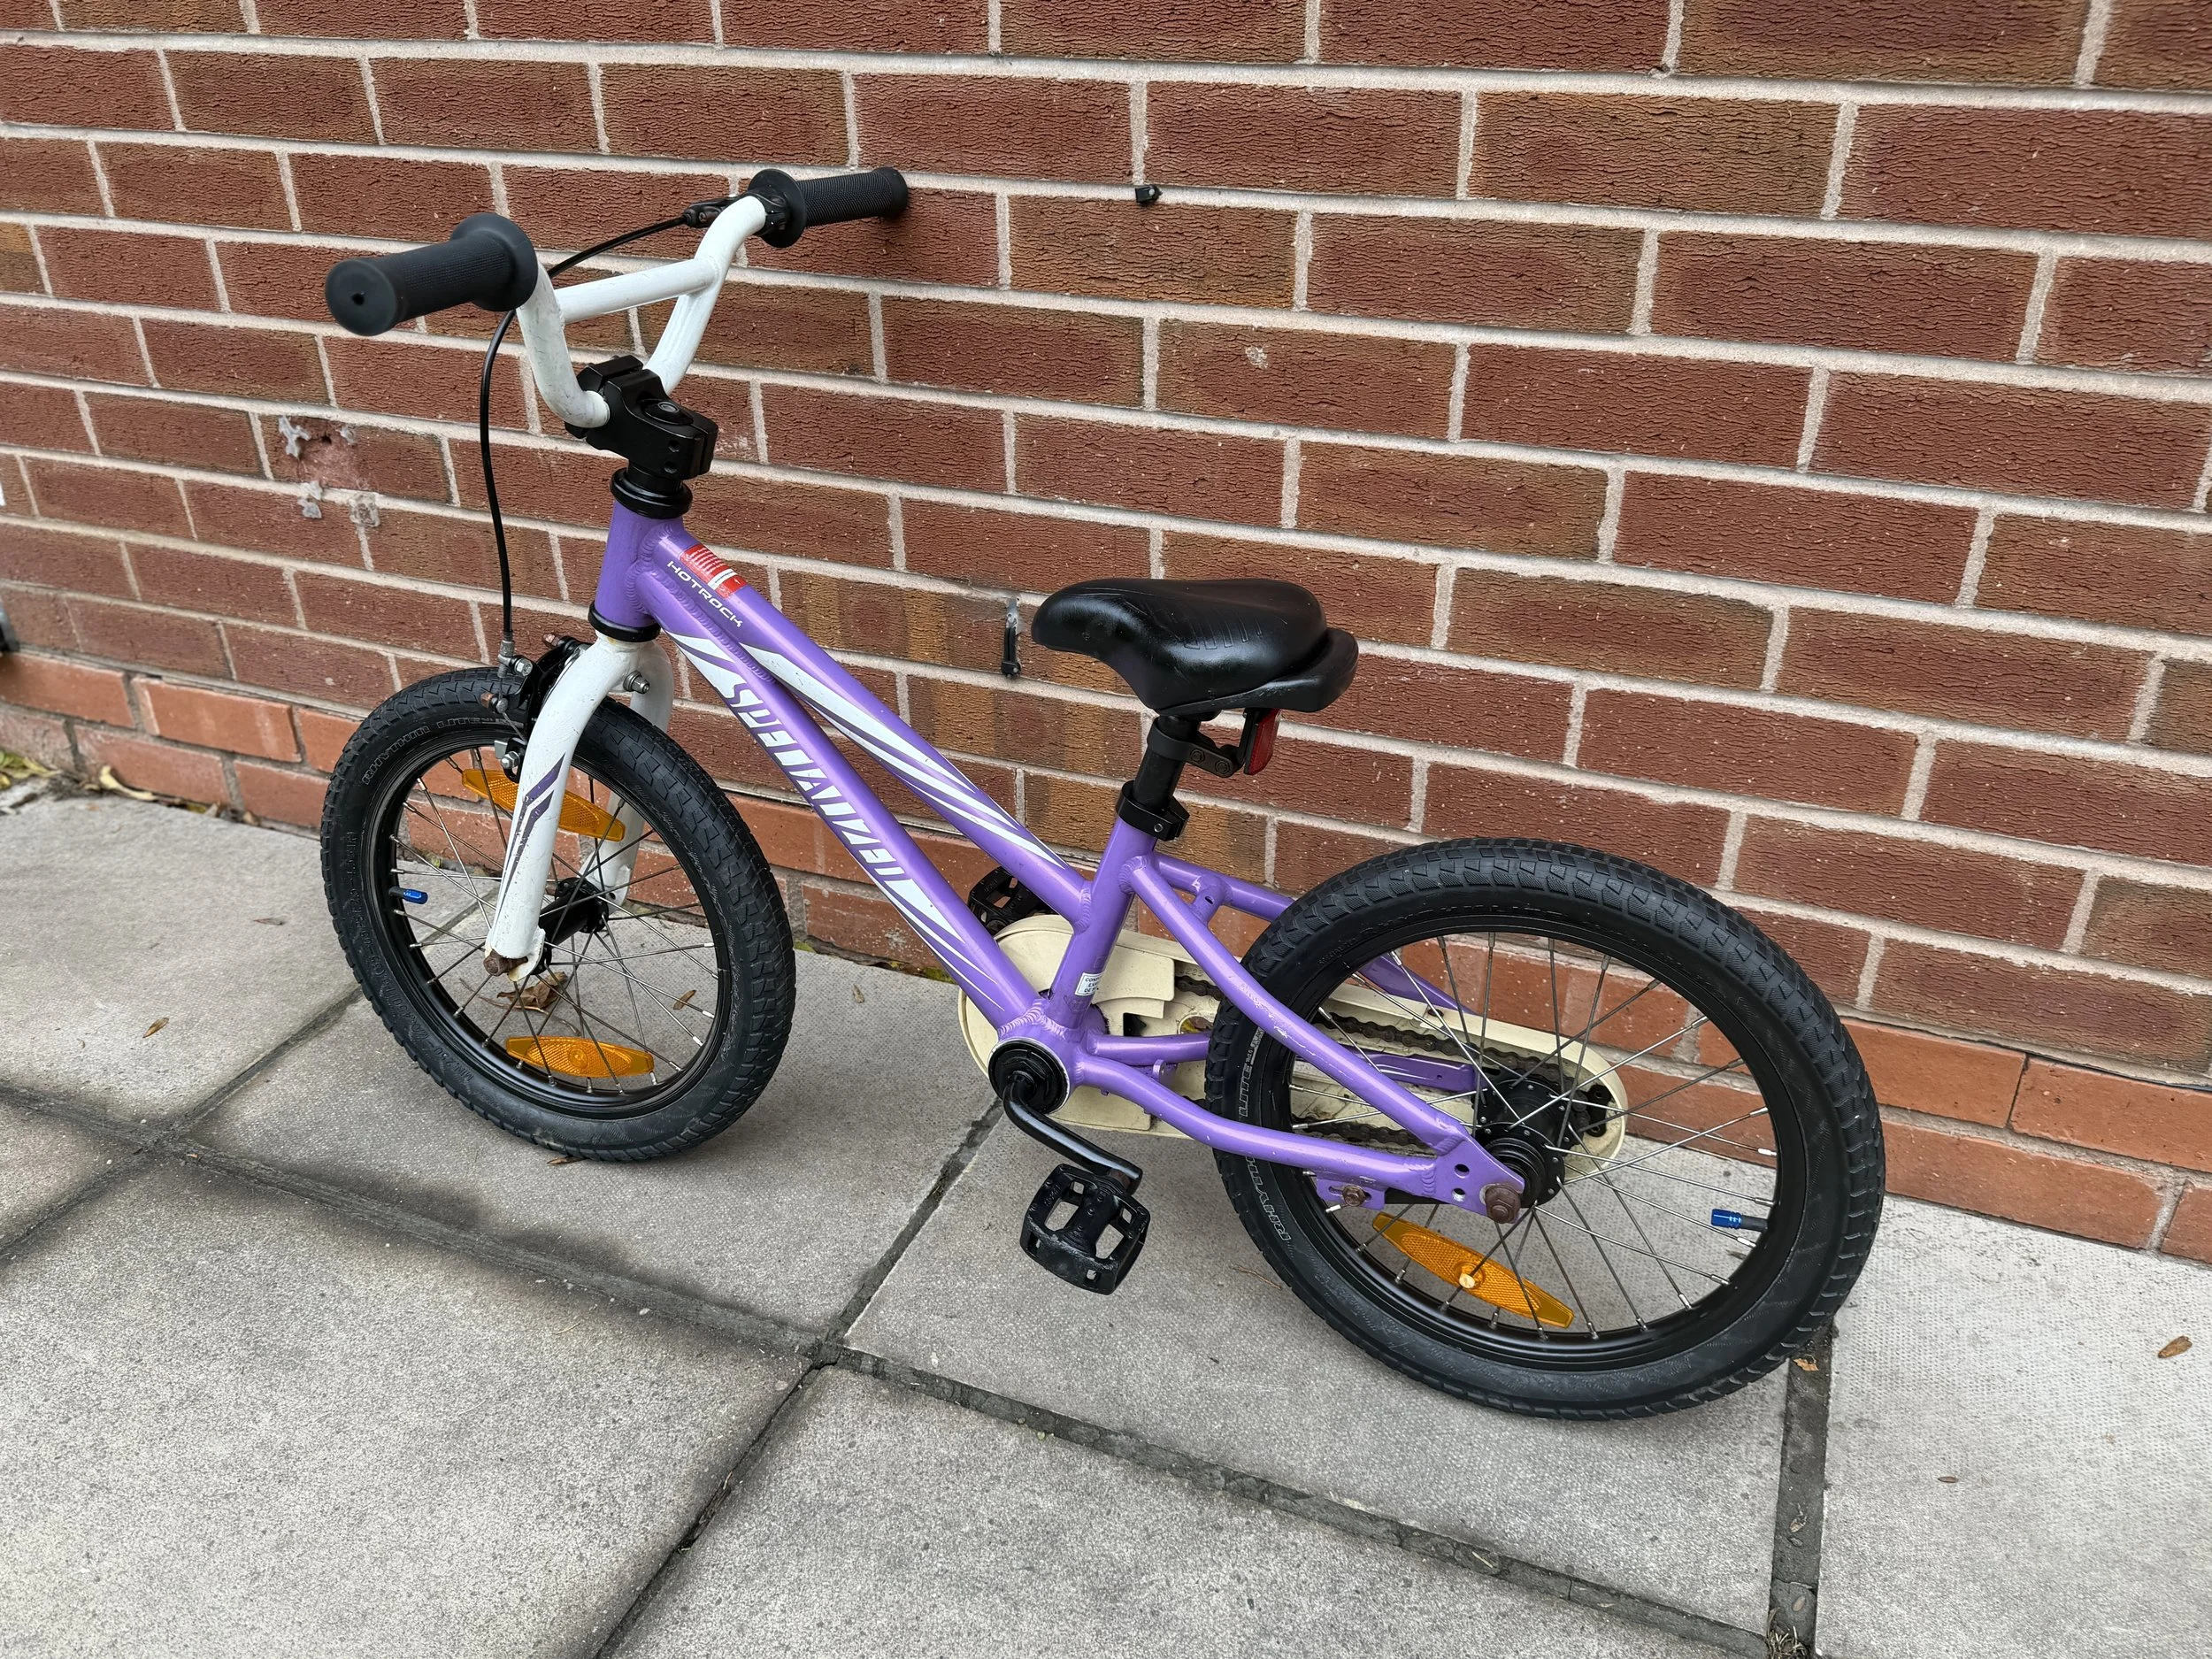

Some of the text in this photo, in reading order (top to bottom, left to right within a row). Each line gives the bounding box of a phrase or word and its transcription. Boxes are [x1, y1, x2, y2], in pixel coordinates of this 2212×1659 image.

[667, 561, 743, 627] HOTROCK
[727, 680, 913, 887] SPECIALIZED
[1238, 1063, 1253, 1118] LITE
[1245, 1156, 1292, 1240] RHYTH
